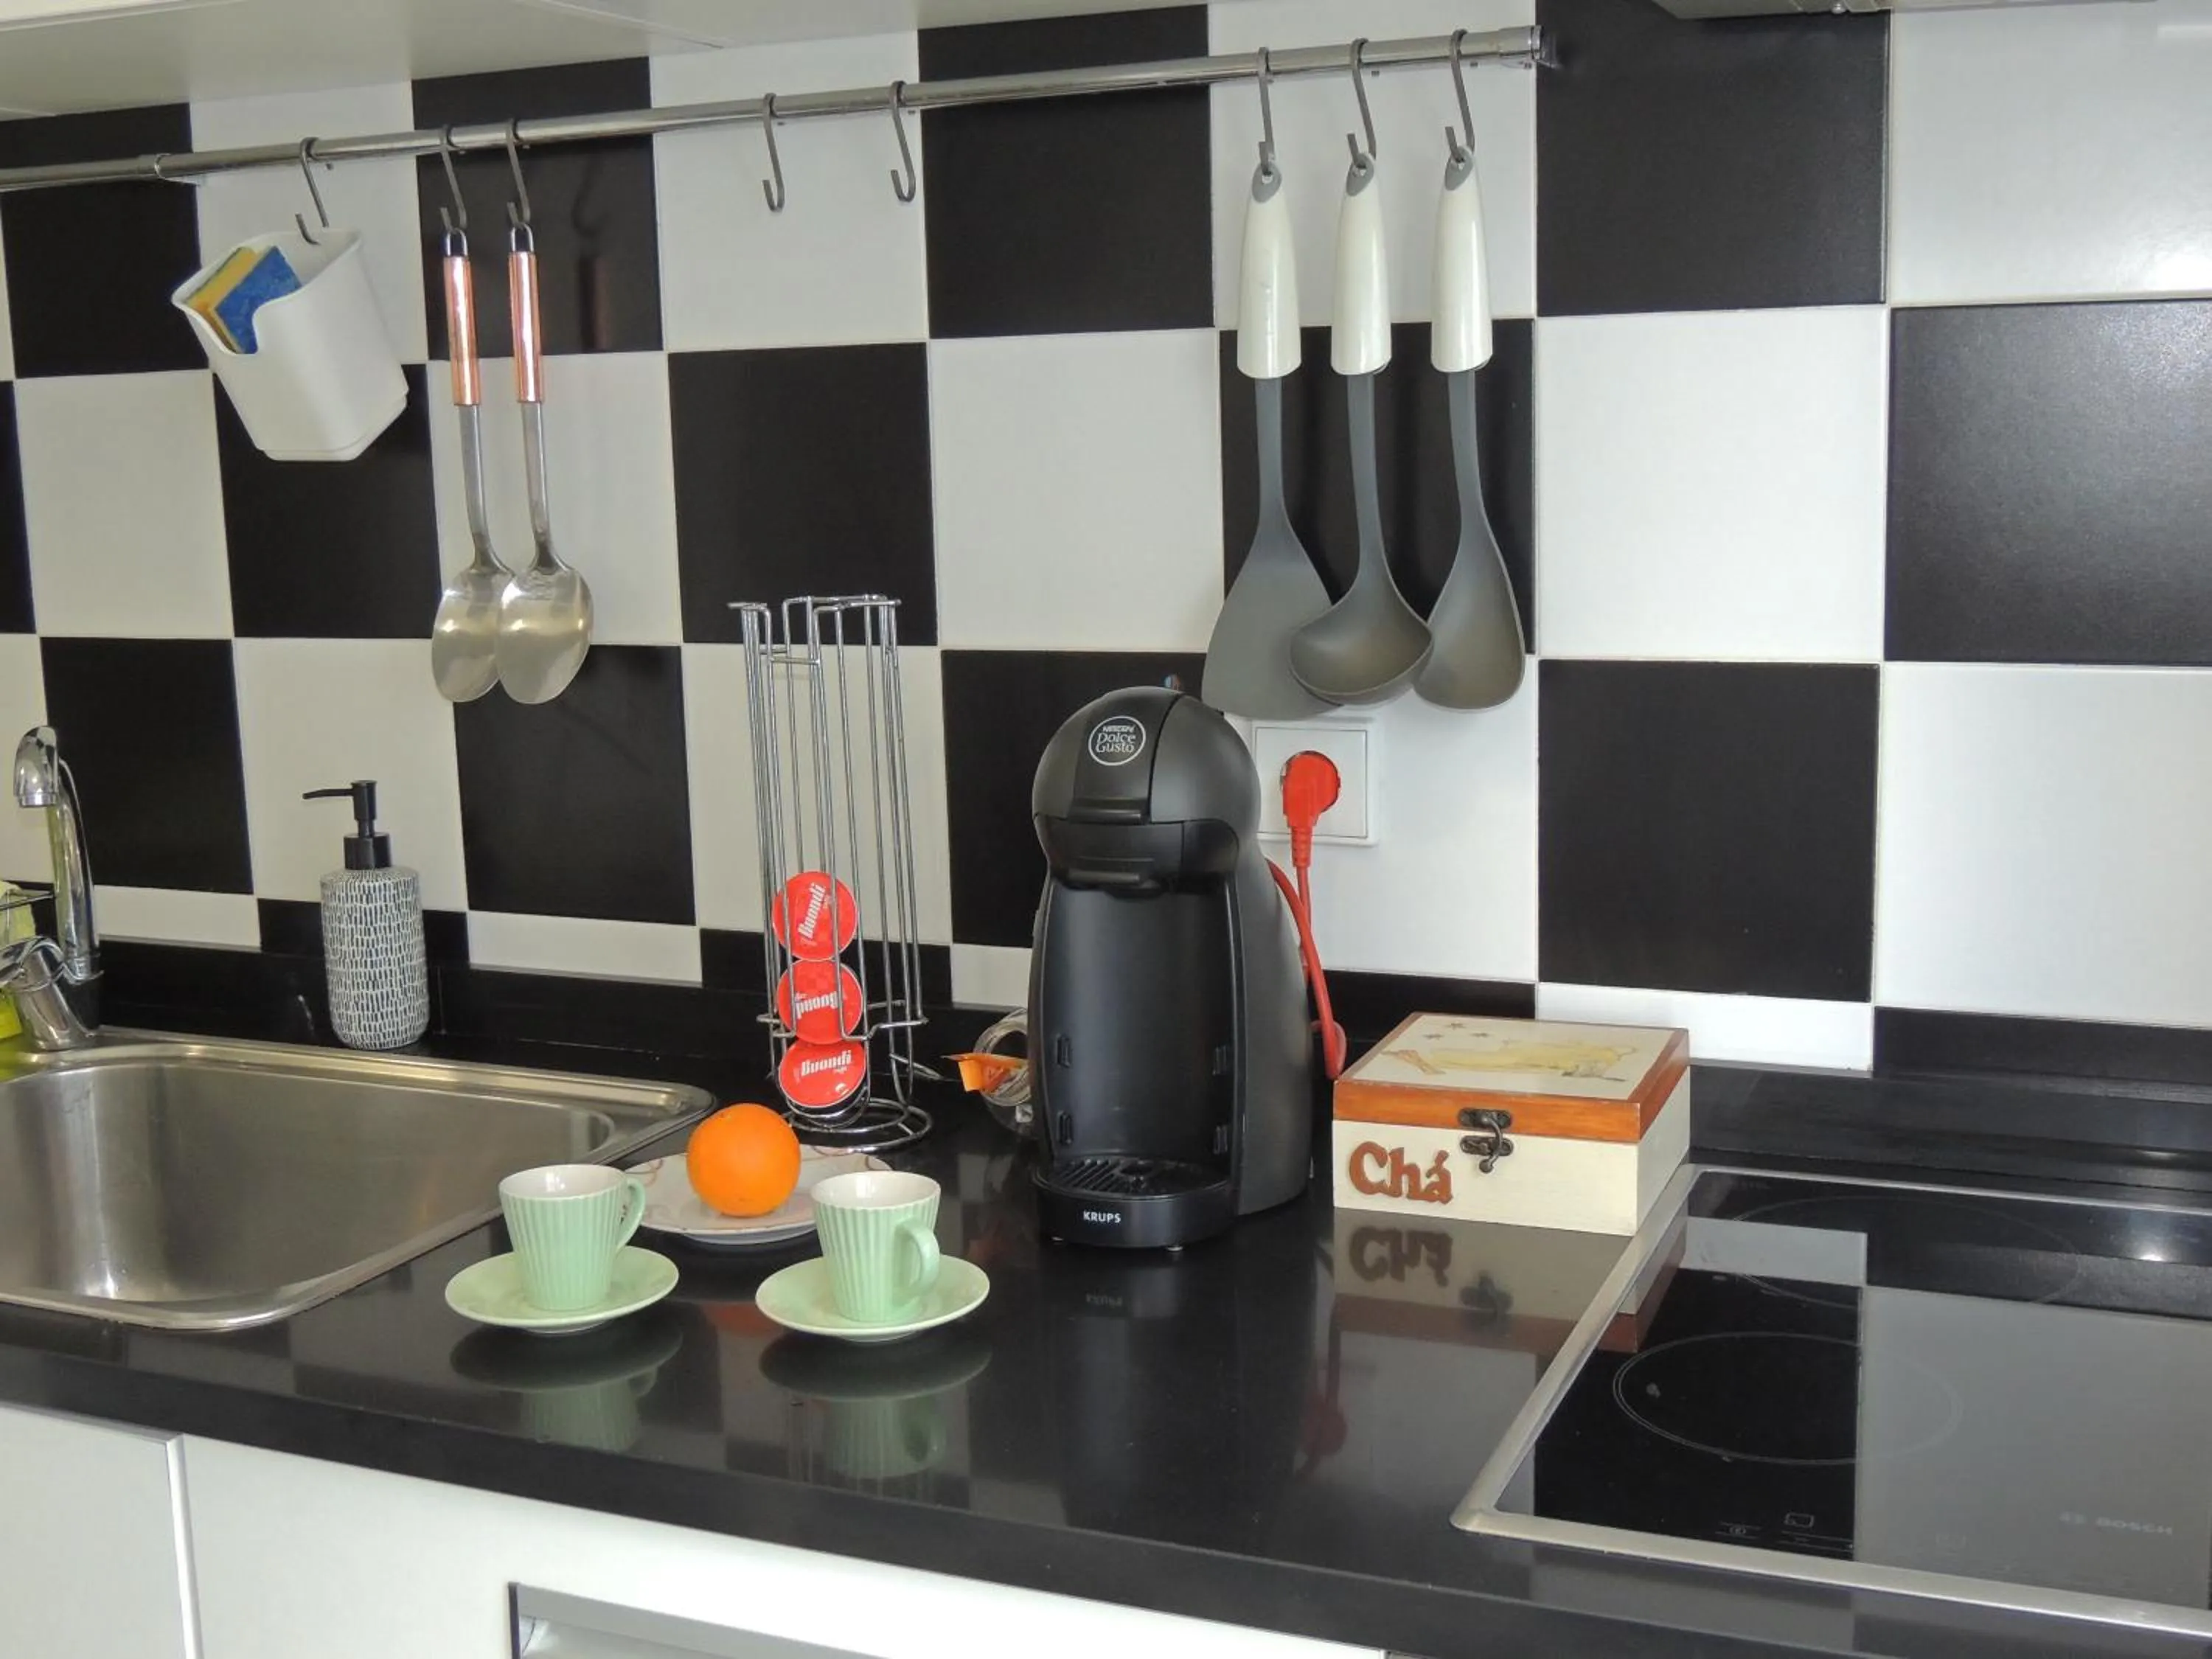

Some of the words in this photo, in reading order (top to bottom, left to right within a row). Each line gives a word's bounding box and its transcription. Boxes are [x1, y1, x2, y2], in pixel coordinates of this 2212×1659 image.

[1098, 732, 1135, 744] Dolce
[1096, 742, 1135, 753] Gusto
[1349, 1141, 1453, 1205] Chá
[1083, 1211, 1121, 1223] KRUPS
